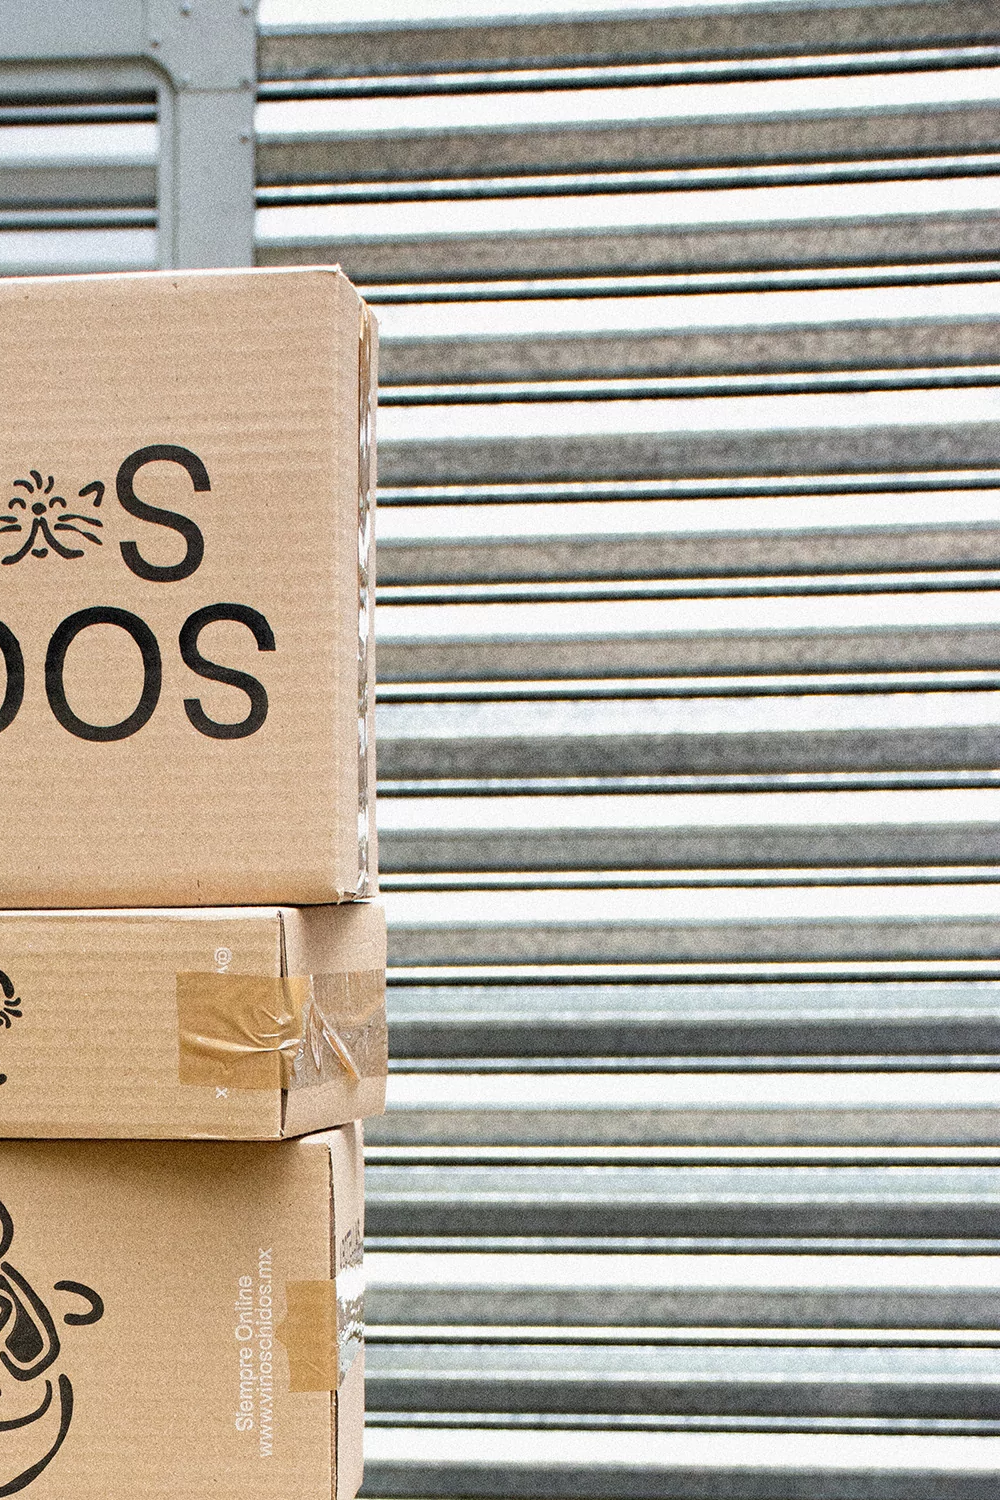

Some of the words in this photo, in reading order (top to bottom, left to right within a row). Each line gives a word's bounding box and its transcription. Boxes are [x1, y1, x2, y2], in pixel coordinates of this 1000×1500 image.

[234, 1275, 253, 1342] Online
[234, 1347, 258, 1432] Siempre
[254, 1247, 273, 1458] www.vinoschidos.mx
